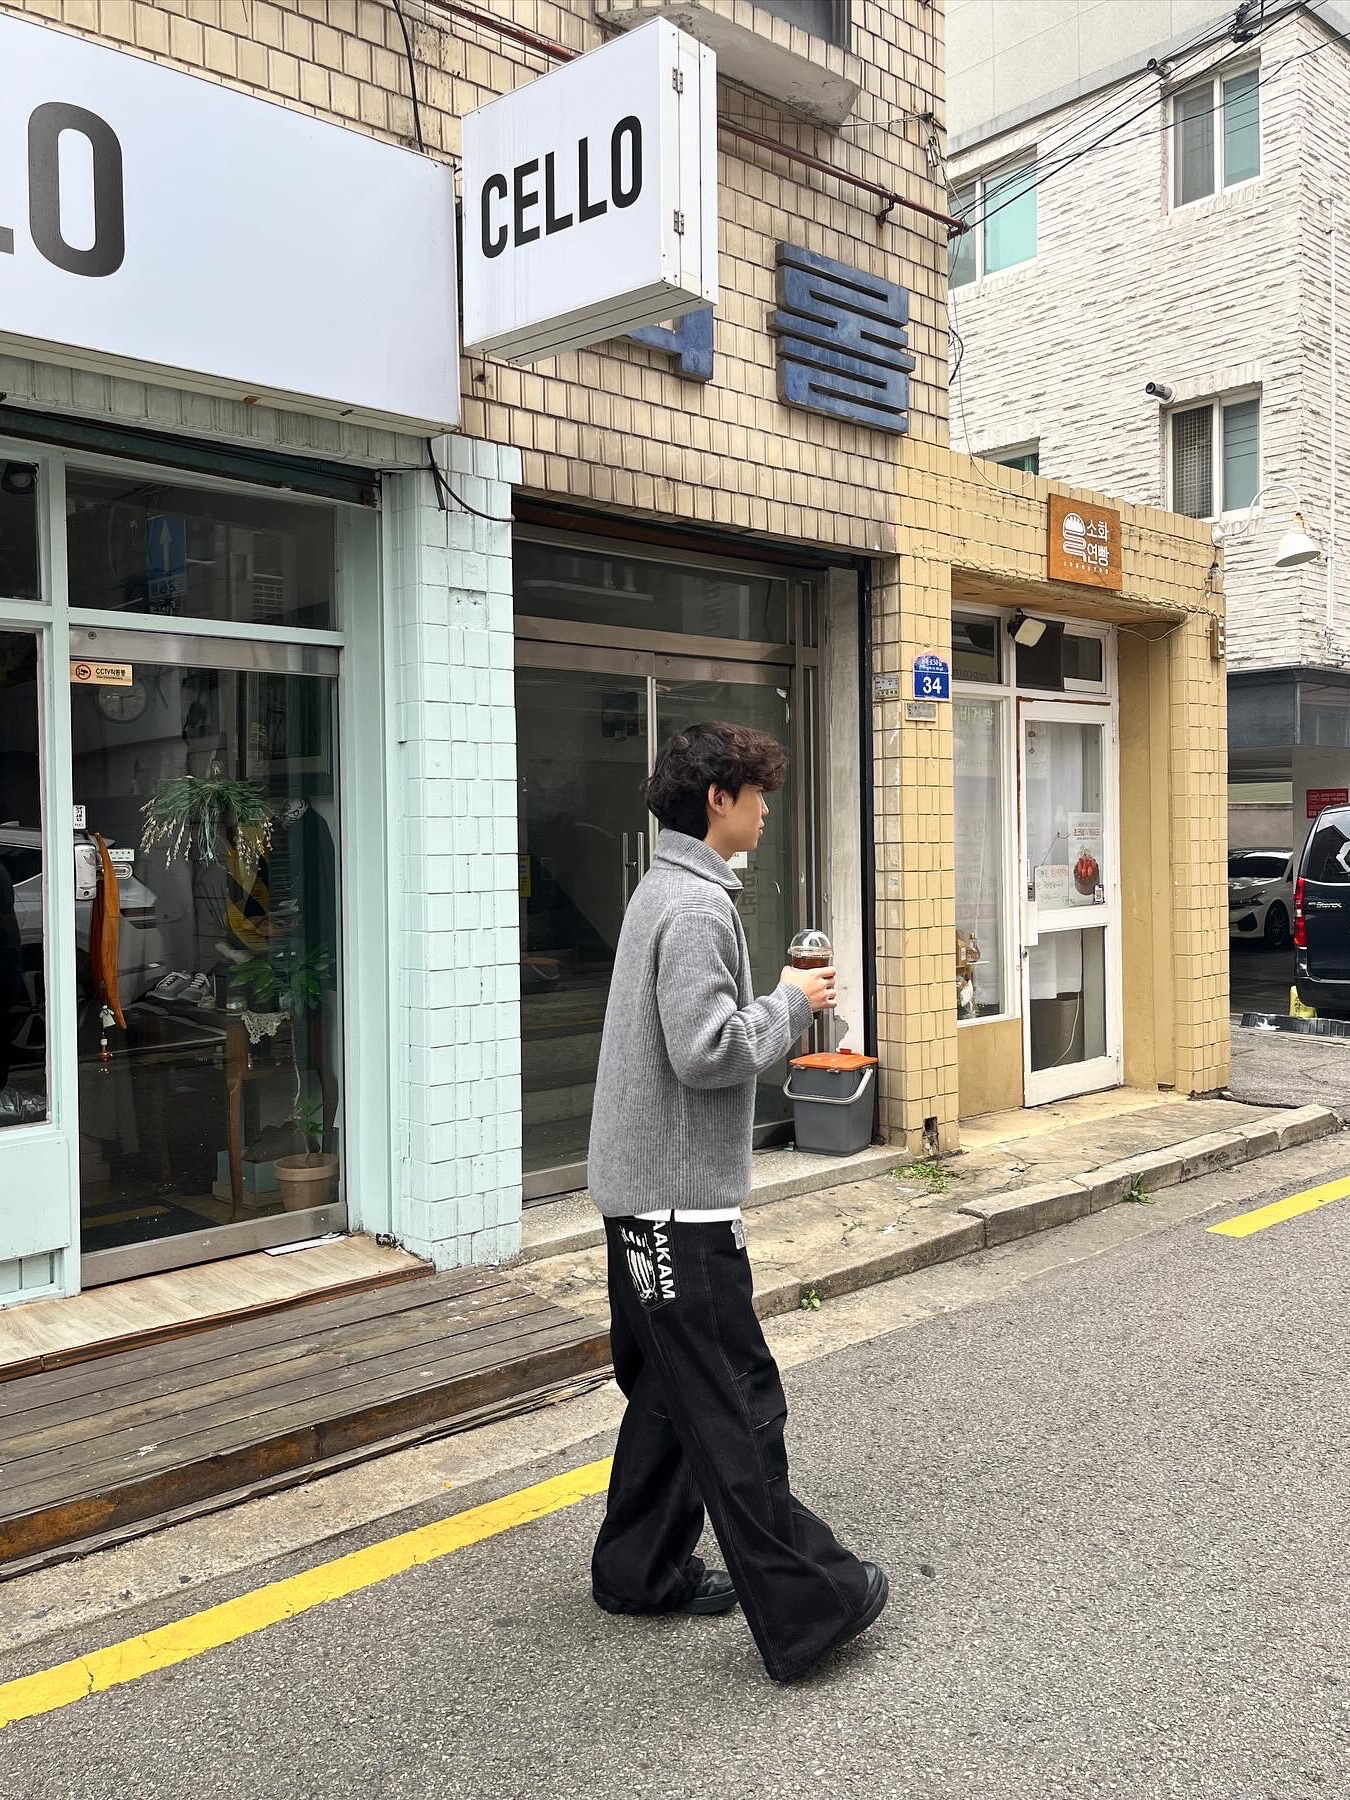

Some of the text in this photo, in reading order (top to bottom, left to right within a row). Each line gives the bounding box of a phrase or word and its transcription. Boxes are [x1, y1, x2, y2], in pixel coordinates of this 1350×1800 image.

[480, 115, 643, 260] CELLO
[1086, 519, 1110, 542] 소화
[1086, 542, 1110, 567] 연빵
[922, 675, 942, 695] 34
